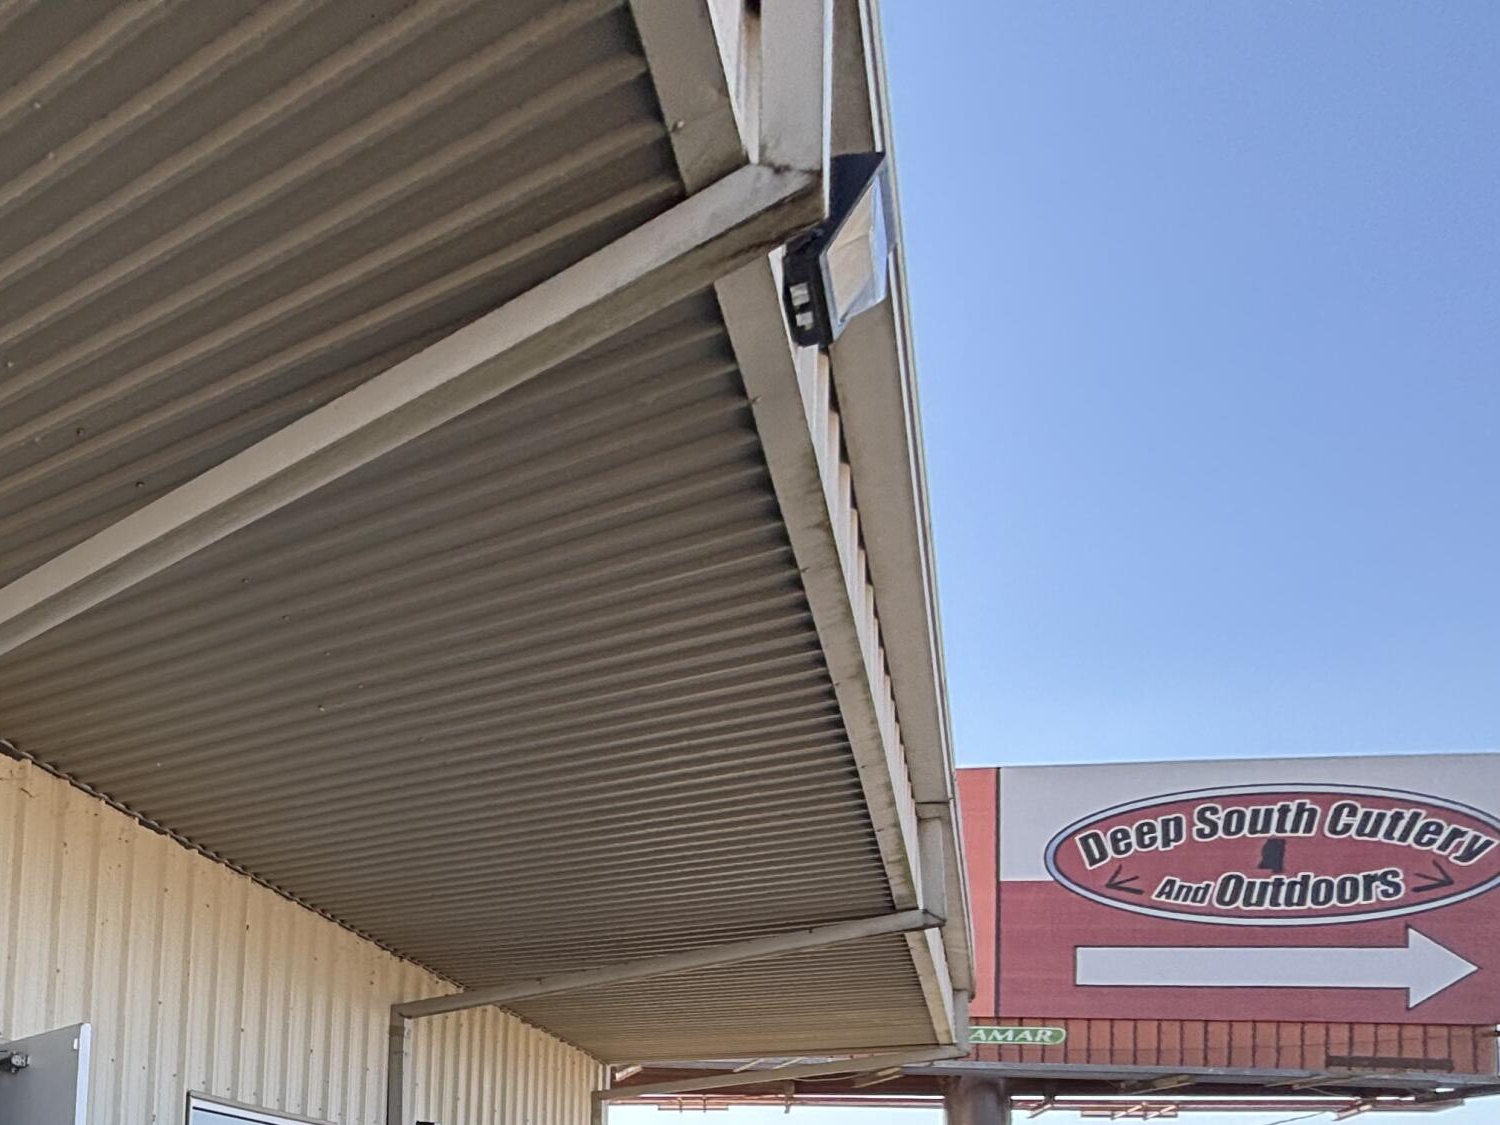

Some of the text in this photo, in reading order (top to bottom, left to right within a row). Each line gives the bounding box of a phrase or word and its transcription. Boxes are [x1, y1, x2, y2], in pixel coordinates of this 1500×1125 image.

[1077, 802, 1496, 868] Deep South Cutlery
[1153, 869, 1403, 909] And Outdoors
[968, 1029, 1054, 1042] AMAR
